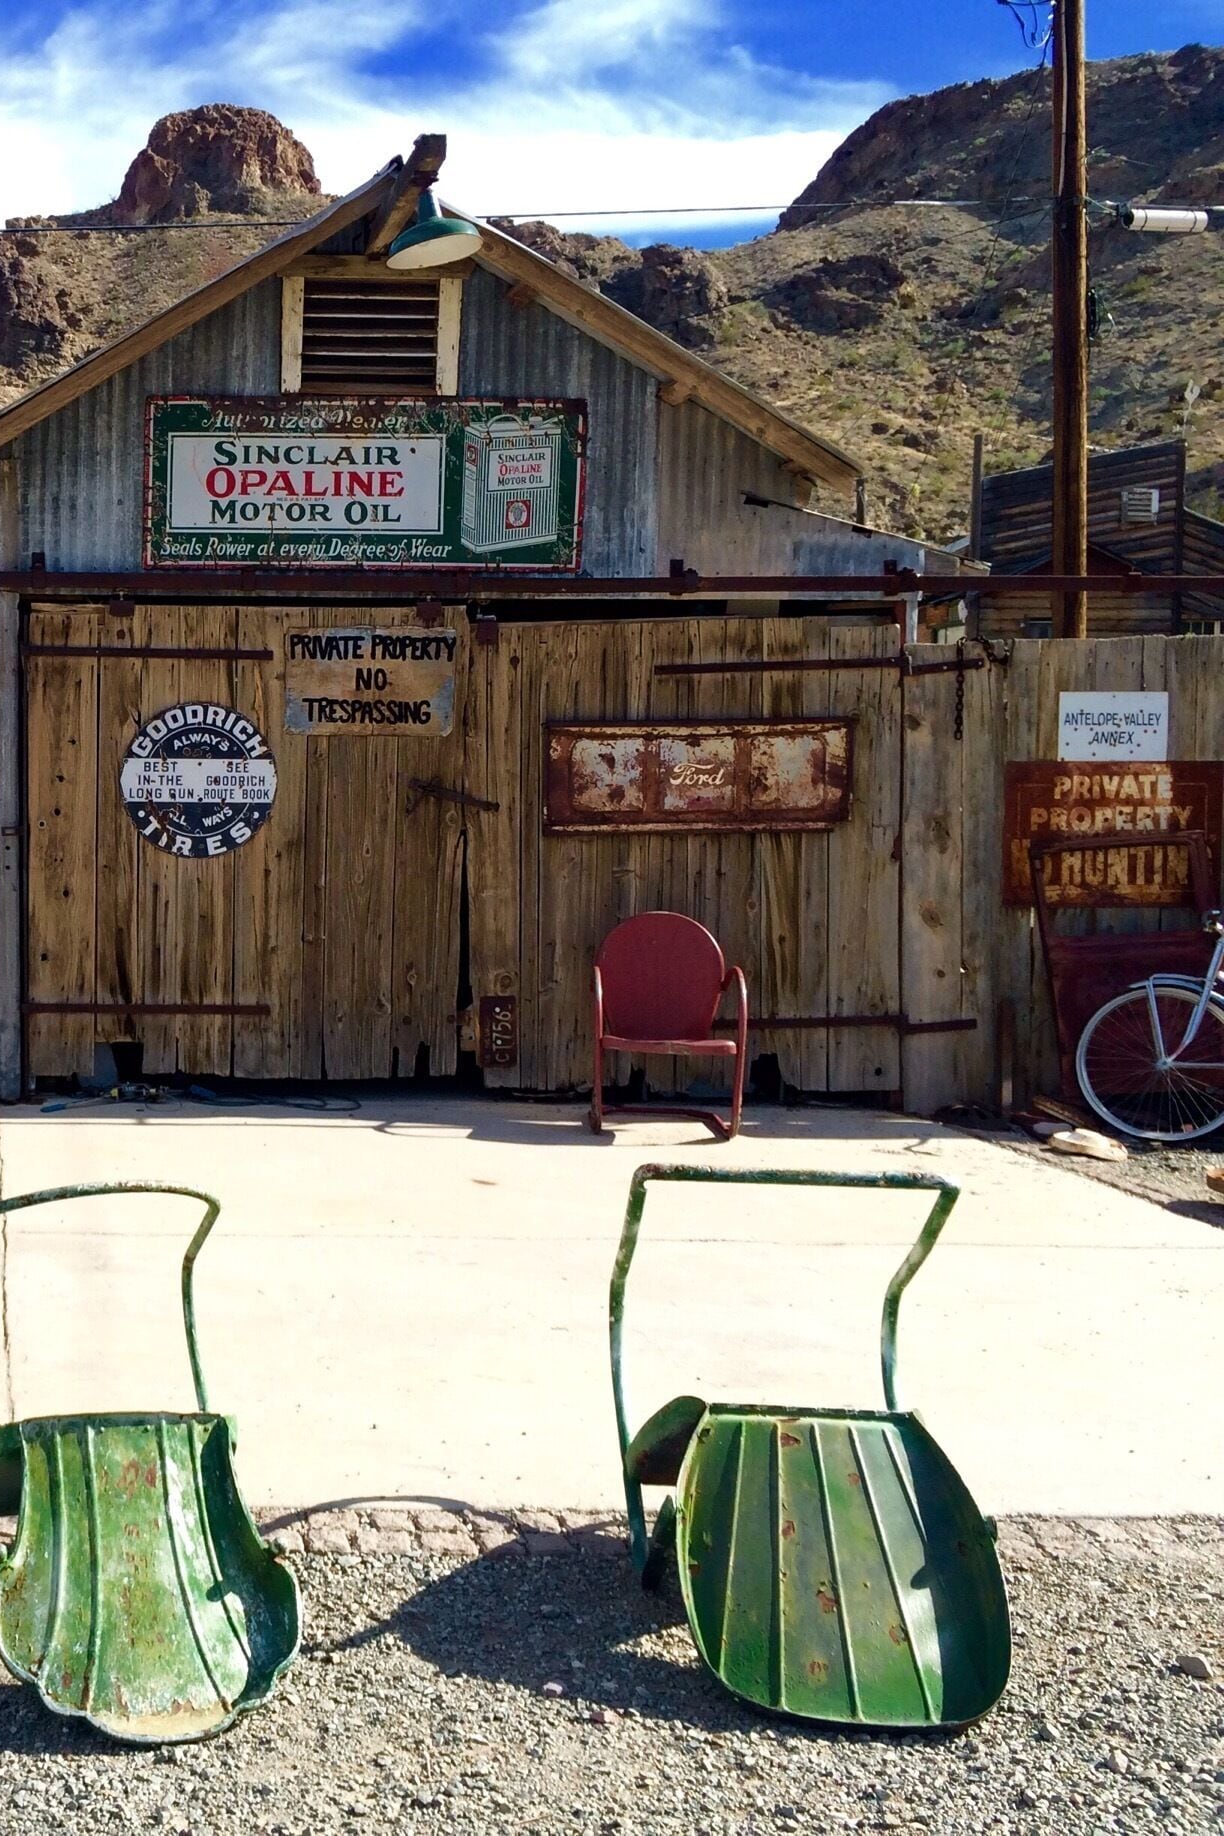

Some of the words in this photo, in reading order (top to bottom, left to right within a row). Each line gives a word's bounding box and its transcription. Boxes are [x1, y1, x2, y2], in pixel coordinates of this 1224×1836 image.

[213, 440, 401, 466] SINCLAIR
[497, 452, 546, 464] SINCLAIR
[497, 476, 527, 487] MOTOR
[529, 474, 544, 484] OIL
[499, 464, 542, 476] OPALINE
[205, 468, 406, 498] OPALINE
[209, 500, 332, 524] MOTOR
[344, 500, 402, 525] OIL
[160, 537, 202, 556] Seals
[205, 537, 255, 557] Power
[257, 539, 275, 556] at
[280, 543, 326, 561] every
[328, 539, 384, 561] Degree
[388, 539, 407, 561] of
[411, 539, 452, 557] Wear
[290, 634, 365, 661] PRIVATE
[370, 635, 457, 662] PROPERTY
[355, 667, 387, 691] NO
[302, 697, 432, 725] TRESPASSING
[131, 705, 268, 758] GOODRICH
[173, 733, 230, 751] ALWAYS
[1090, 731, 1135, 745] ANNEX
[143, 762, 178, 772] BEST
[226, 763, 250, 773] SEE
[669, 763, 725, 786] Ford
[206, 776, 266, 787] GOODRICH
[1053, 775, 1173, 800] PRIVATE
[129, 788, 163, 799] LONG
[203, 789, 235, 799] ROUTE
[242, 789, 270, 800] BOOK
[202, 806, 233, 827] WAYS
[1030, 806, 1194, 831] PROPERTY
[142, 815, 252, 857] TIRES
